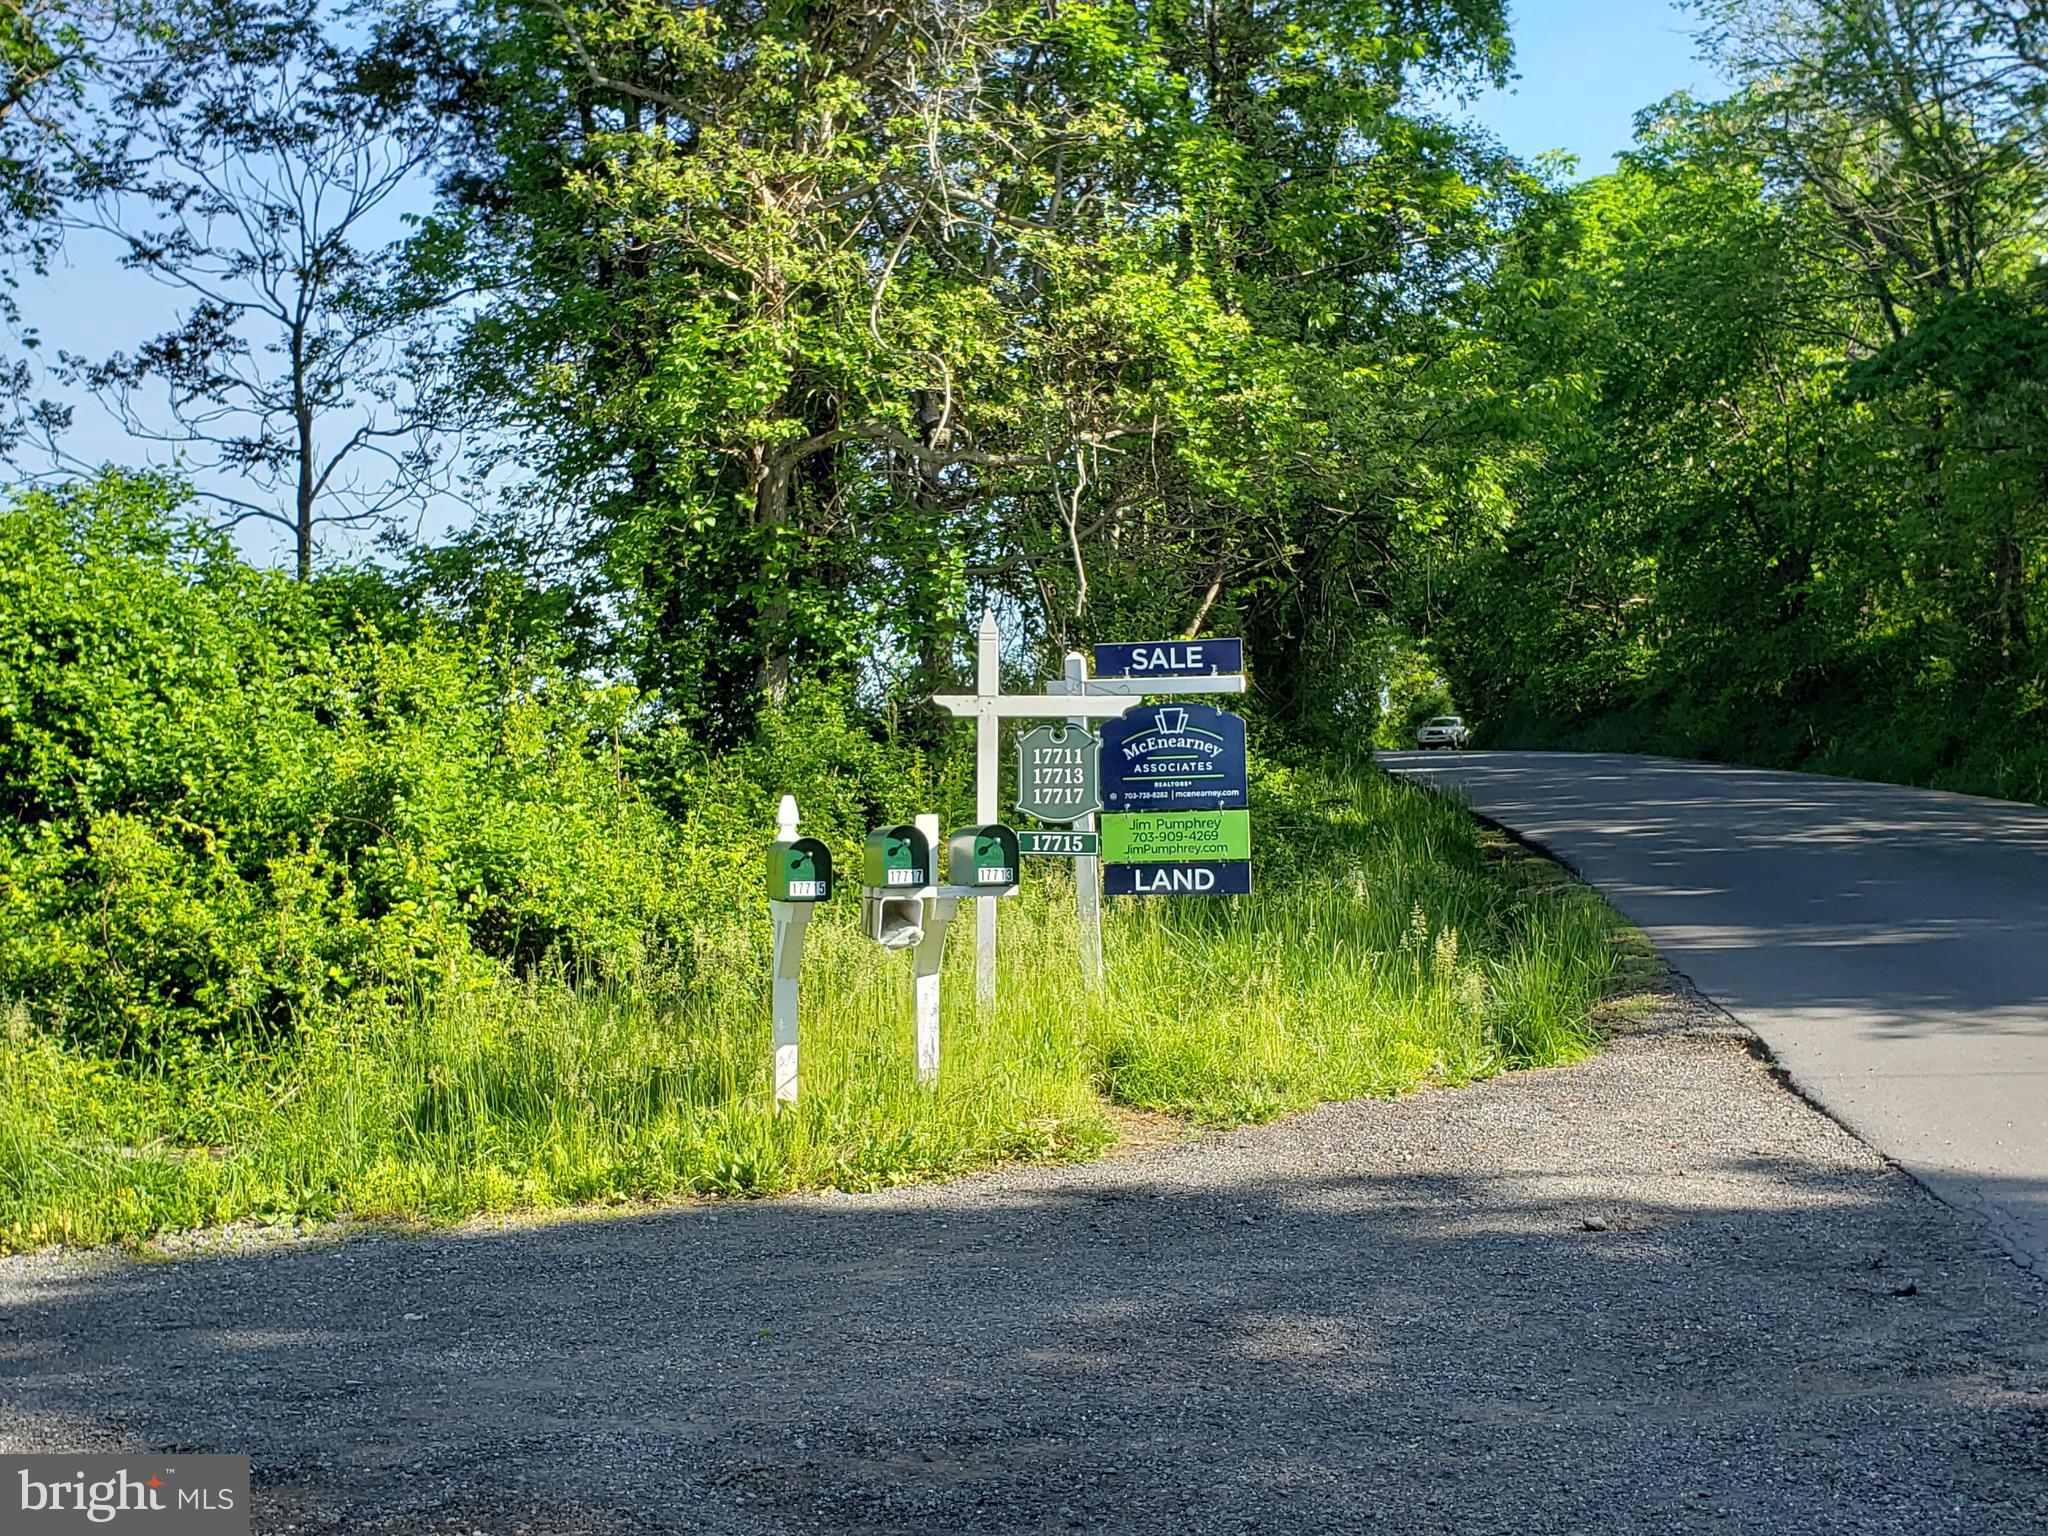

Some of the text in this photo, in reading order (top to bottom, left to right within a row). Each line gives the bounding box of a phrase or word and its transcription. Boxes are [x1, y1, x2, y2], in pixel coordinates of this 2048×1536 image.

[1132, 646, 1204, 670] SALE
[1033, 747, 1083, 764] 17711
[1122, 736, 1224, 761] McEnearney
[1134, 761, 1213, 773] ASSOCIATES
[1033, 767, 1084, 784] 17713
[1033, 787, 1084, 804] 17717
[1175, 789, 1240, 799] mcenearney.com
[1129, 817, 1222, 831] Jim Pumphrey
[1032, 835, 1083, 852] 17715
[1133, 830, 1219, 843] 703-909-4269
[1124, 843, 1228, 856] JimPumphrey.com
[890, 869, 922, 884] 17717
[980, 868, 1012, 882] 17713
[1135, 868, 1215, 892] LAND
